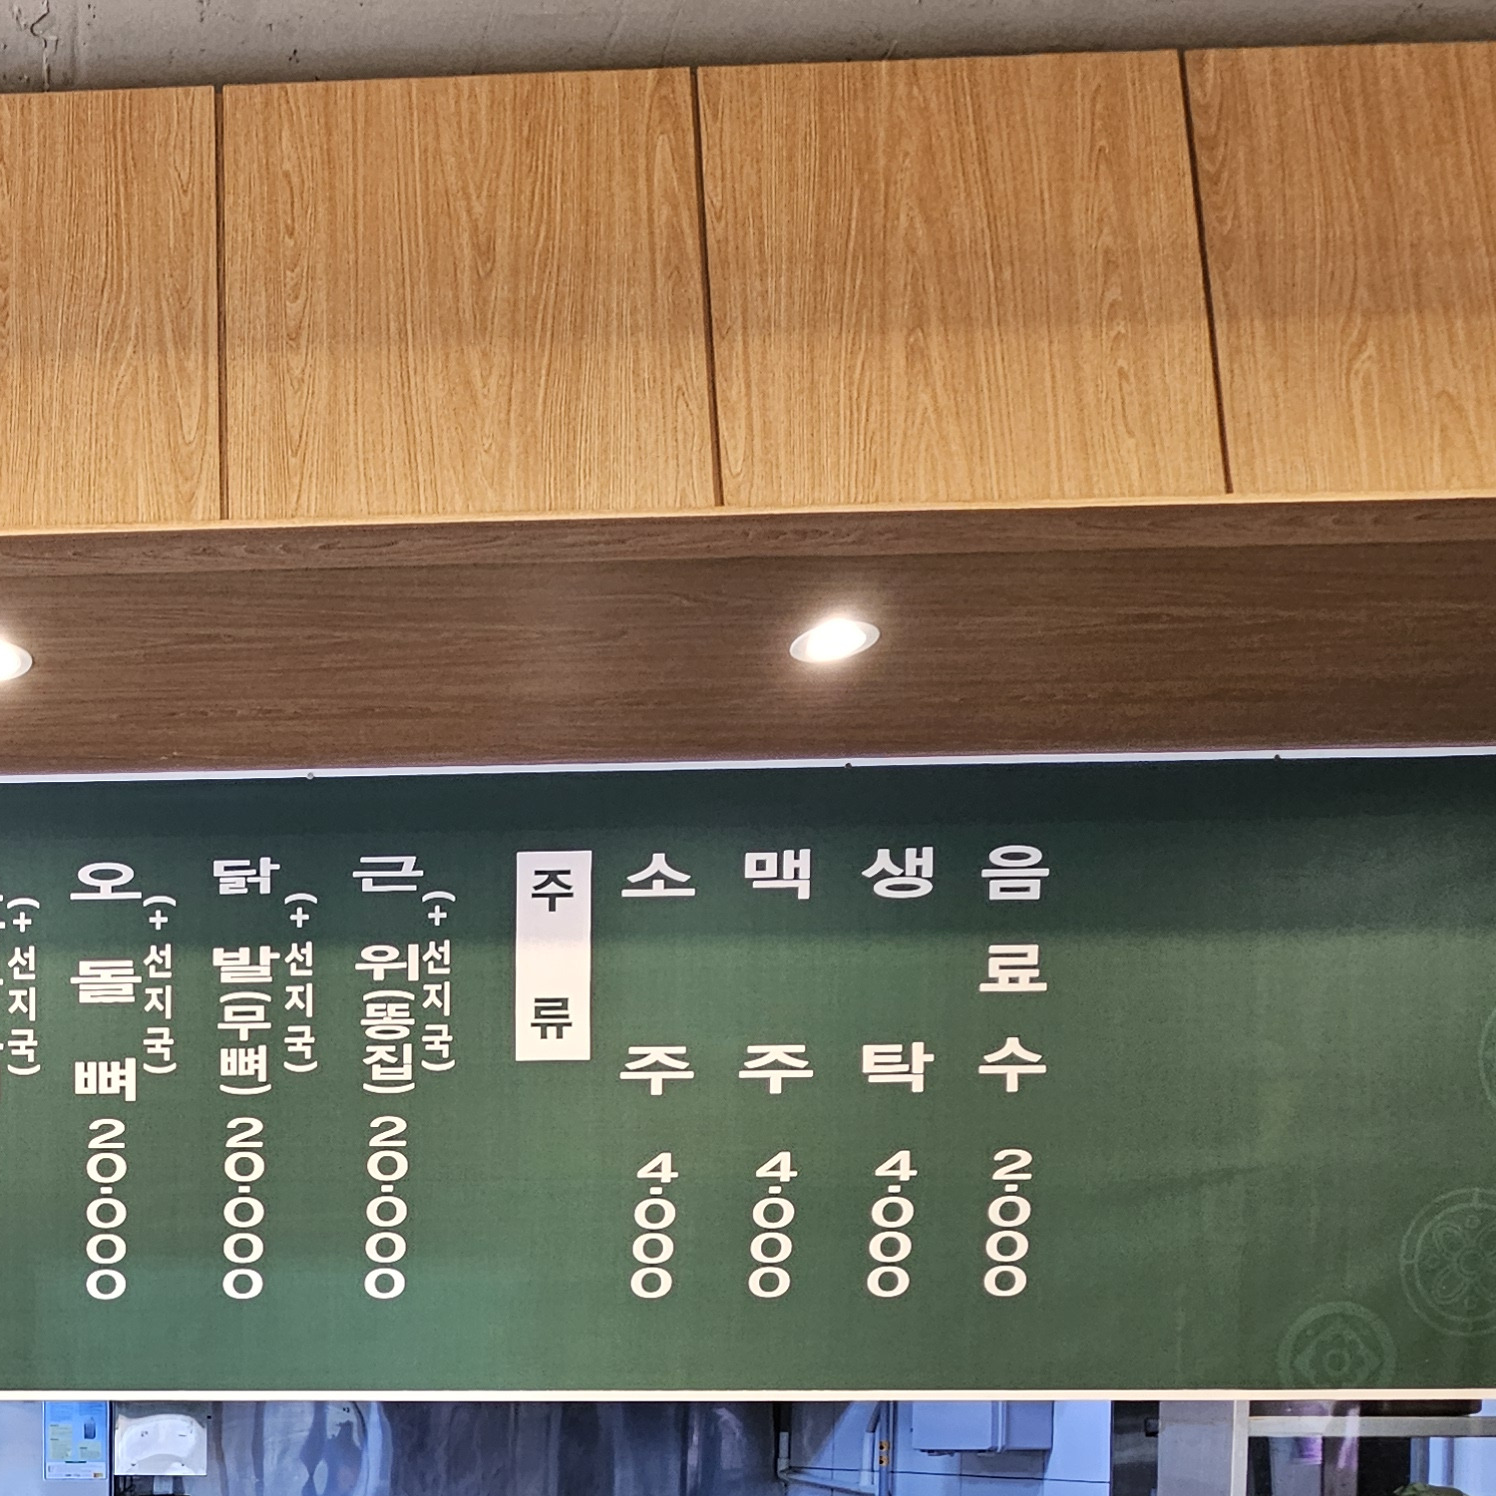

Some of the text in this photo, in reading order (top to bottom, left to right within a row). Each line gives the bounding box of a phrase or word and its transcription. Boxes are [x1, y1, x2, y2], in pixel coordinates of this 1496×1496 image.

[69, 862, 143, 1301] 오돌뼈 20.000
[530, 869, 574, 1039] 주류
[619, 852, 696, 1299] 소주 4.000
[738, 848, 814, 1299] 맥주 4.000
[861, 846, 935, 1298] 생탁 4.000
[977, 845, 1050, 1297] 음료수 2.000
[222, 1116, 265, 1300] 20.000
[363, 1115, 409, 1300] 20.000
